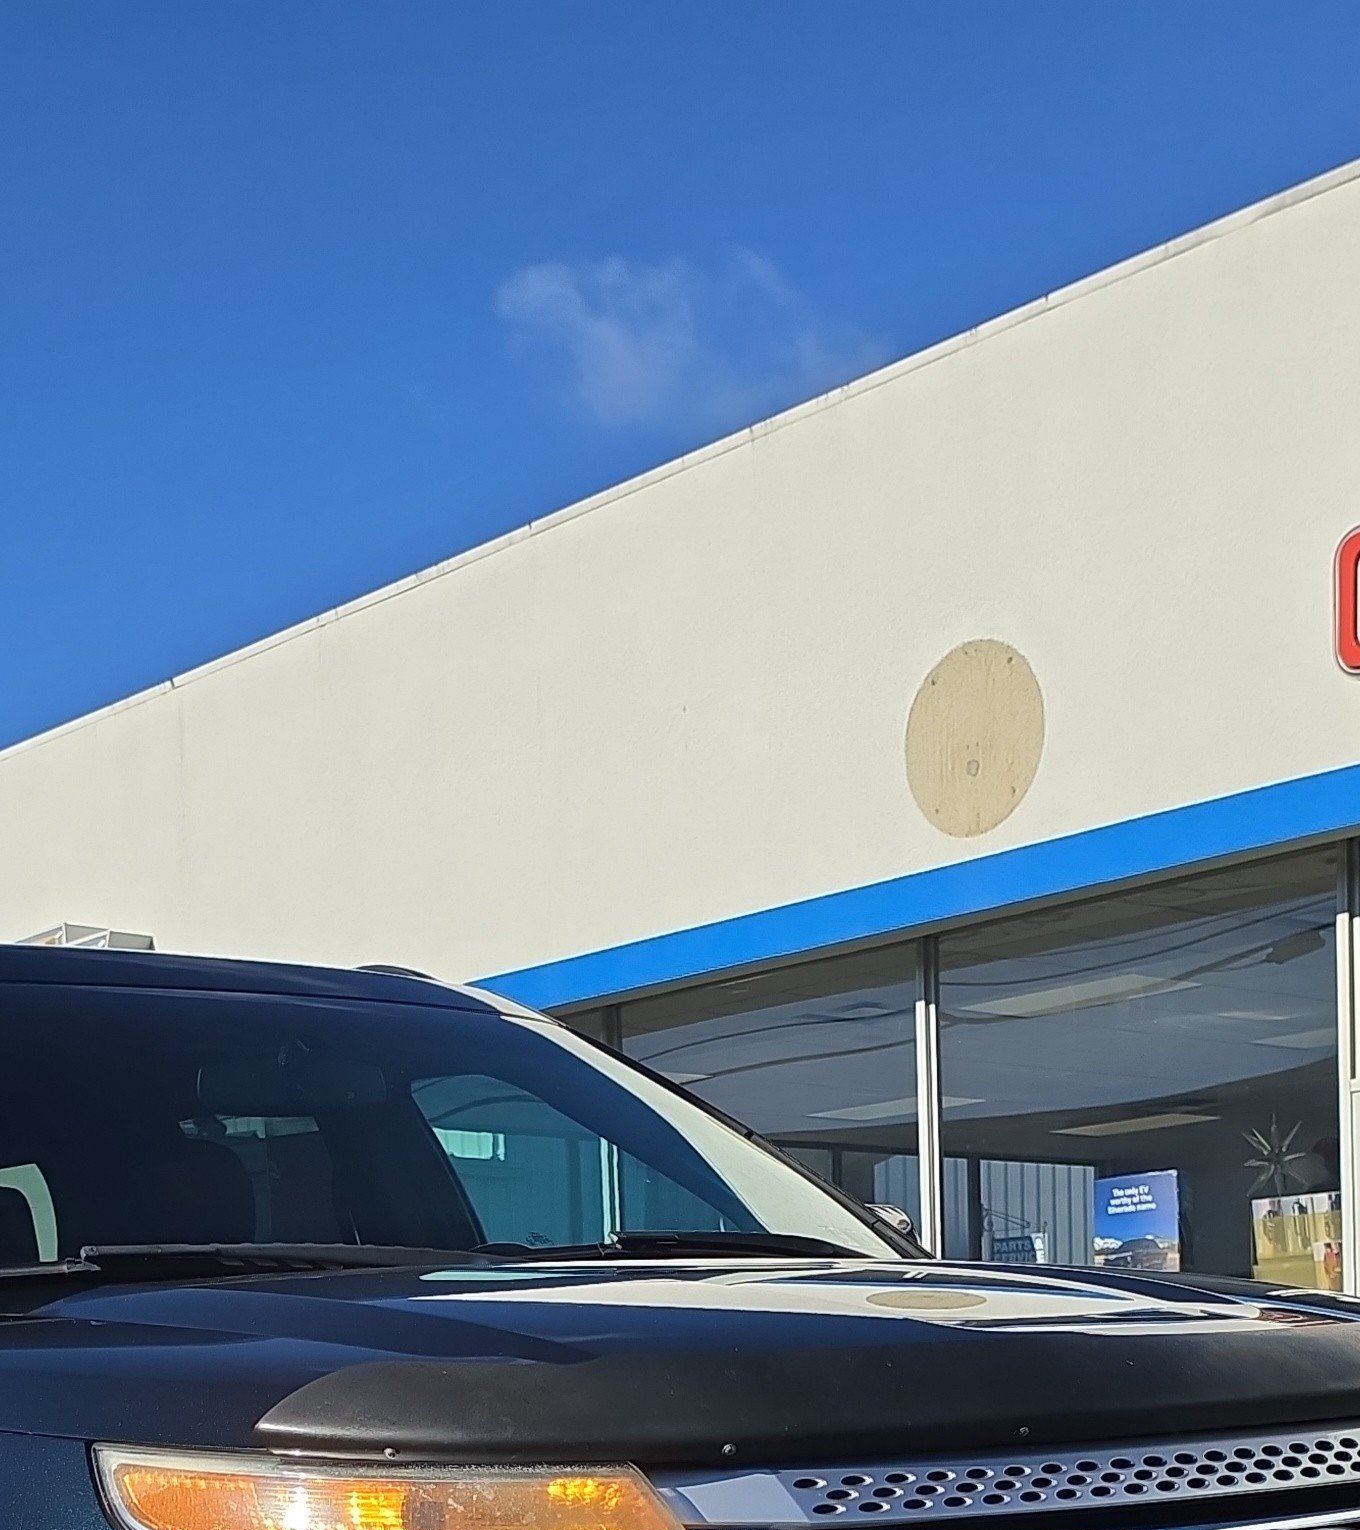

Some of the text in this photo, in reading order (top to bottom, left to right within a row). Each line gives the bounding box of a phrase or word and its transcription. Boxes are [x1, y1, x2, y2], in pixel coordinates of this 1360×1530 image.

[1112, 1185, 1149, 1197] The only EV
[1110, 1197, 1131, 1206] worthy
[1140, 1194, 1153, 1202] the
[1136, 1202, 1157, 1212] name
[993, 1240, 1031, 1252] PARTS
